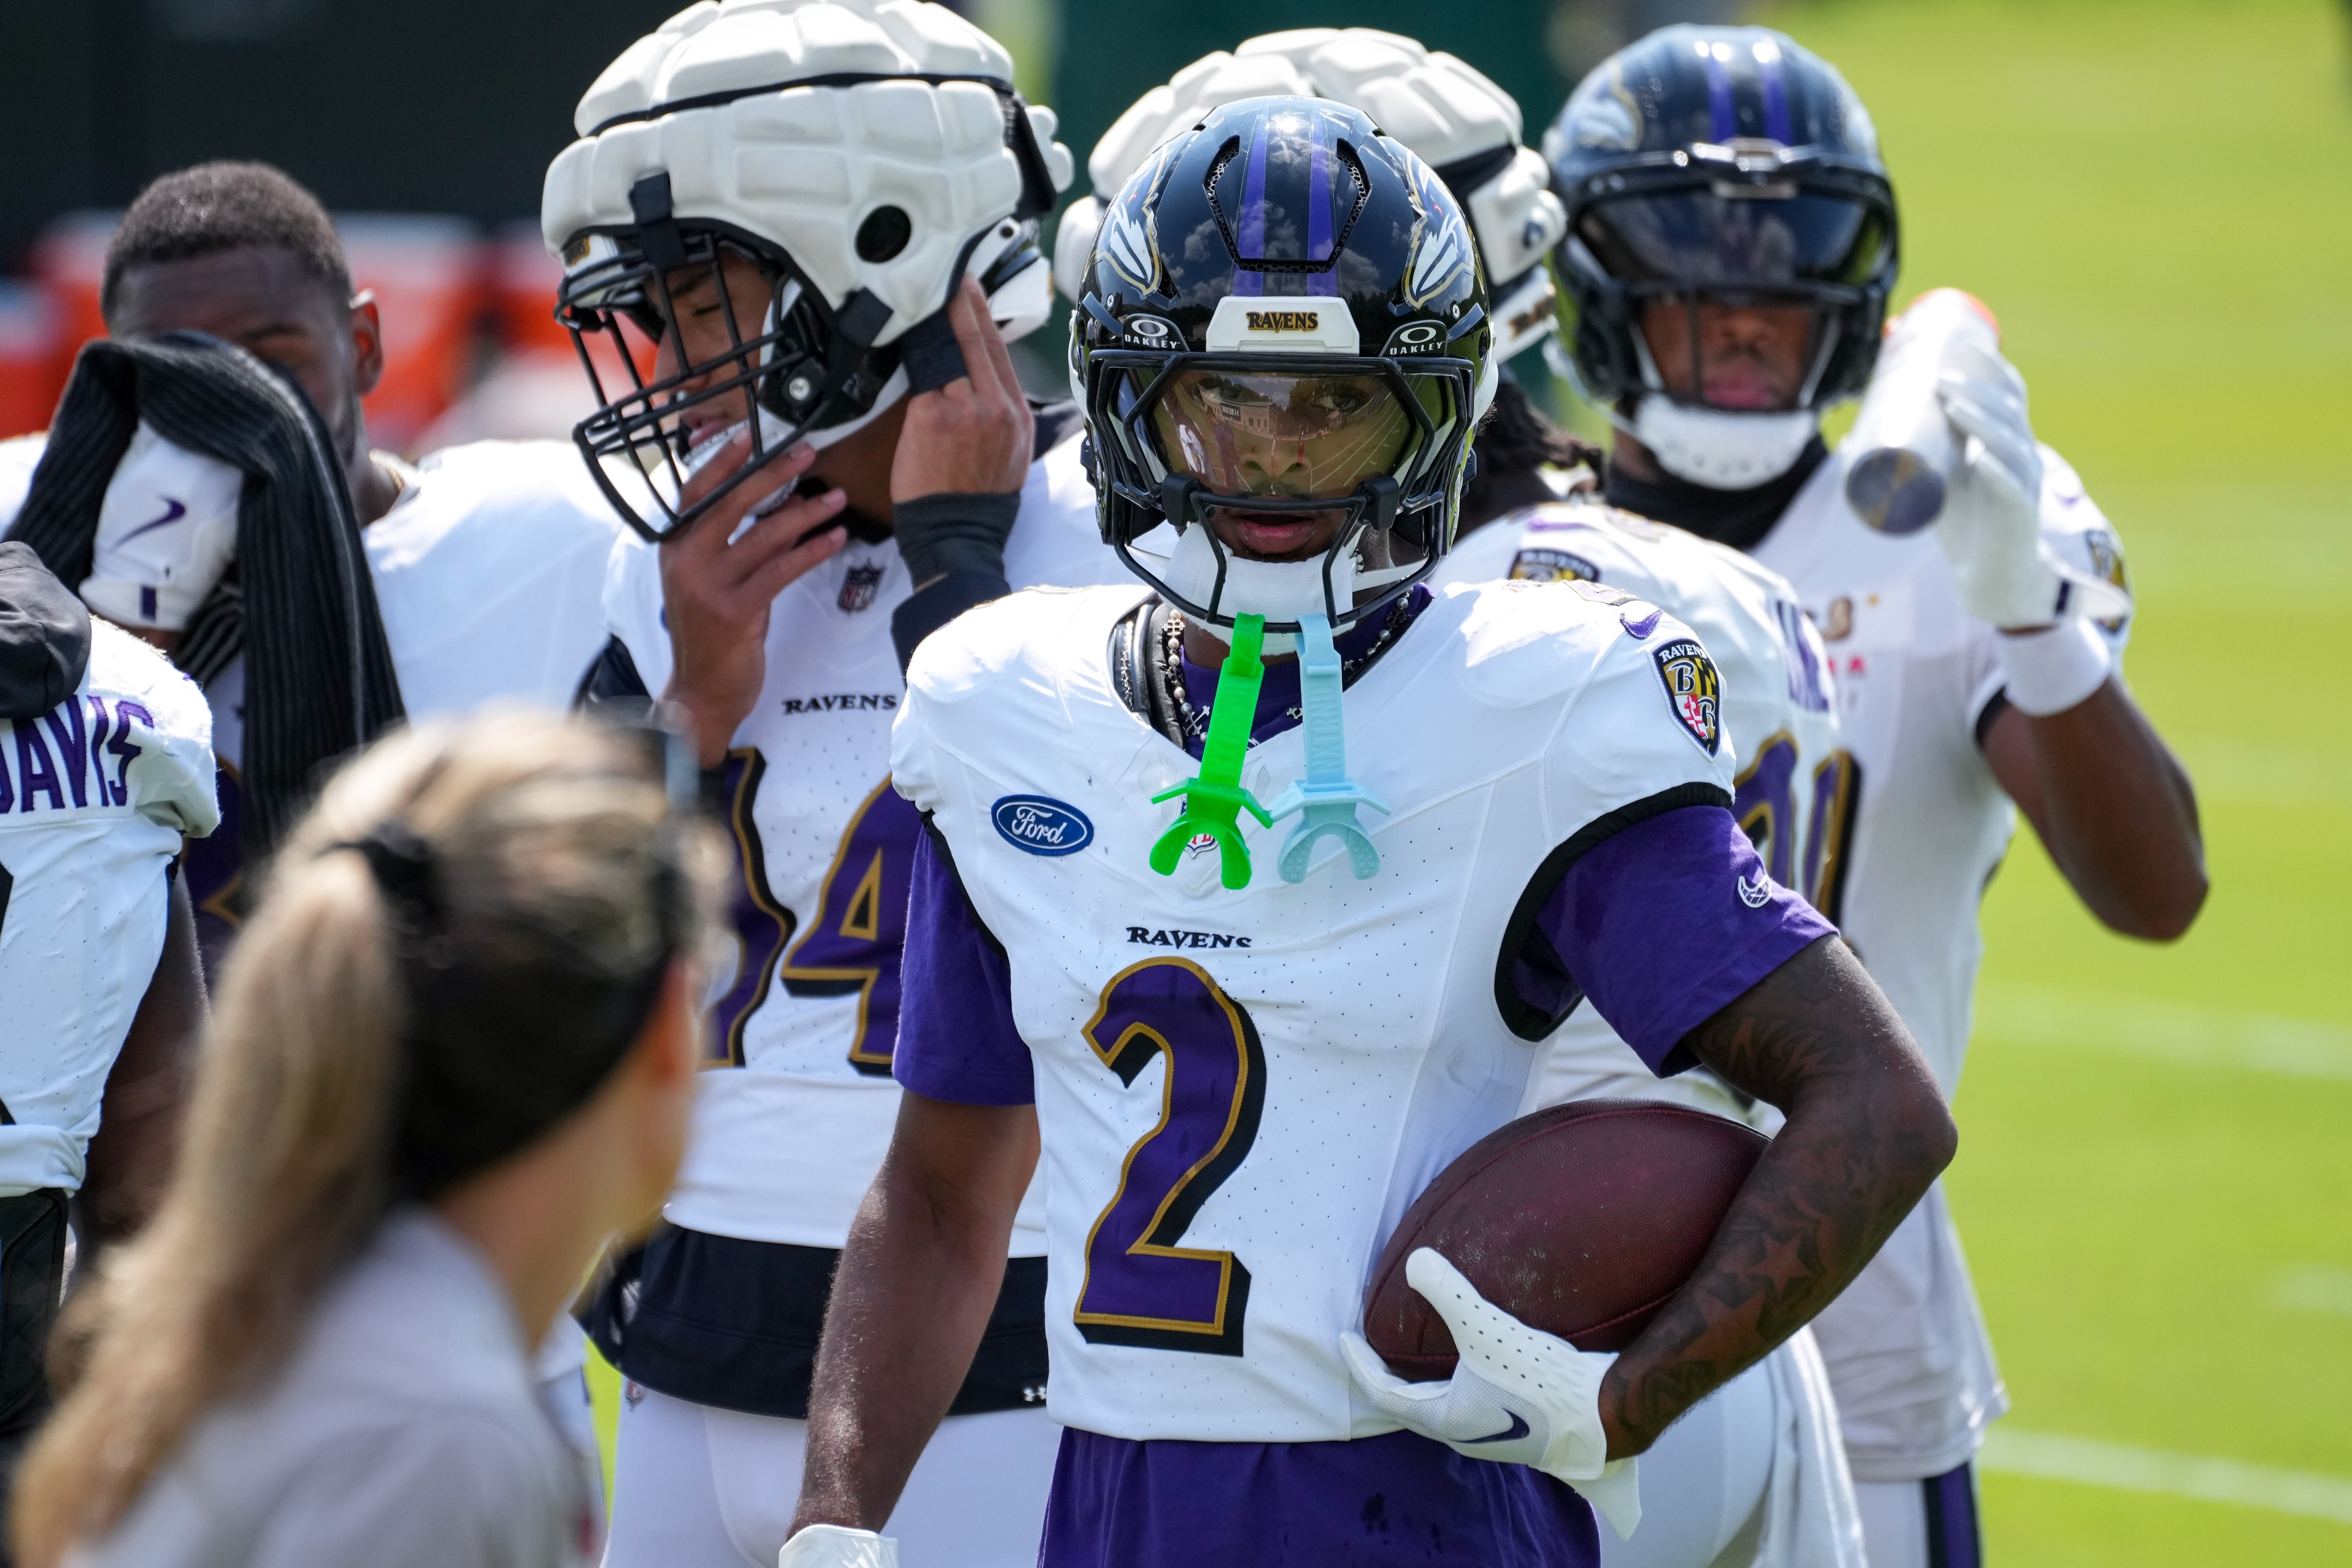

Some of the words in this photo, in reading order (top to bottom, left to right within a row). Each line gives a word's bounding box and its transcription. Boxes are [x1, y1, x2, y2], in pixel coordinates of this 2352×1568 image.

[1246, 311, 1318, 333] RAVENS
[1124, 334, 1177, 349] OAKLEY
[1390, 342, 1443, 355] OAKLEY
[1659, 644, 1708, 663] RAVENS
[781, 694, 898, 716] RAVENS
[1012, 805, 1067, 845] Ford
[1125, 925, 1252, 950] RAVENS
[1073, 955, 1267, 1357] 2
